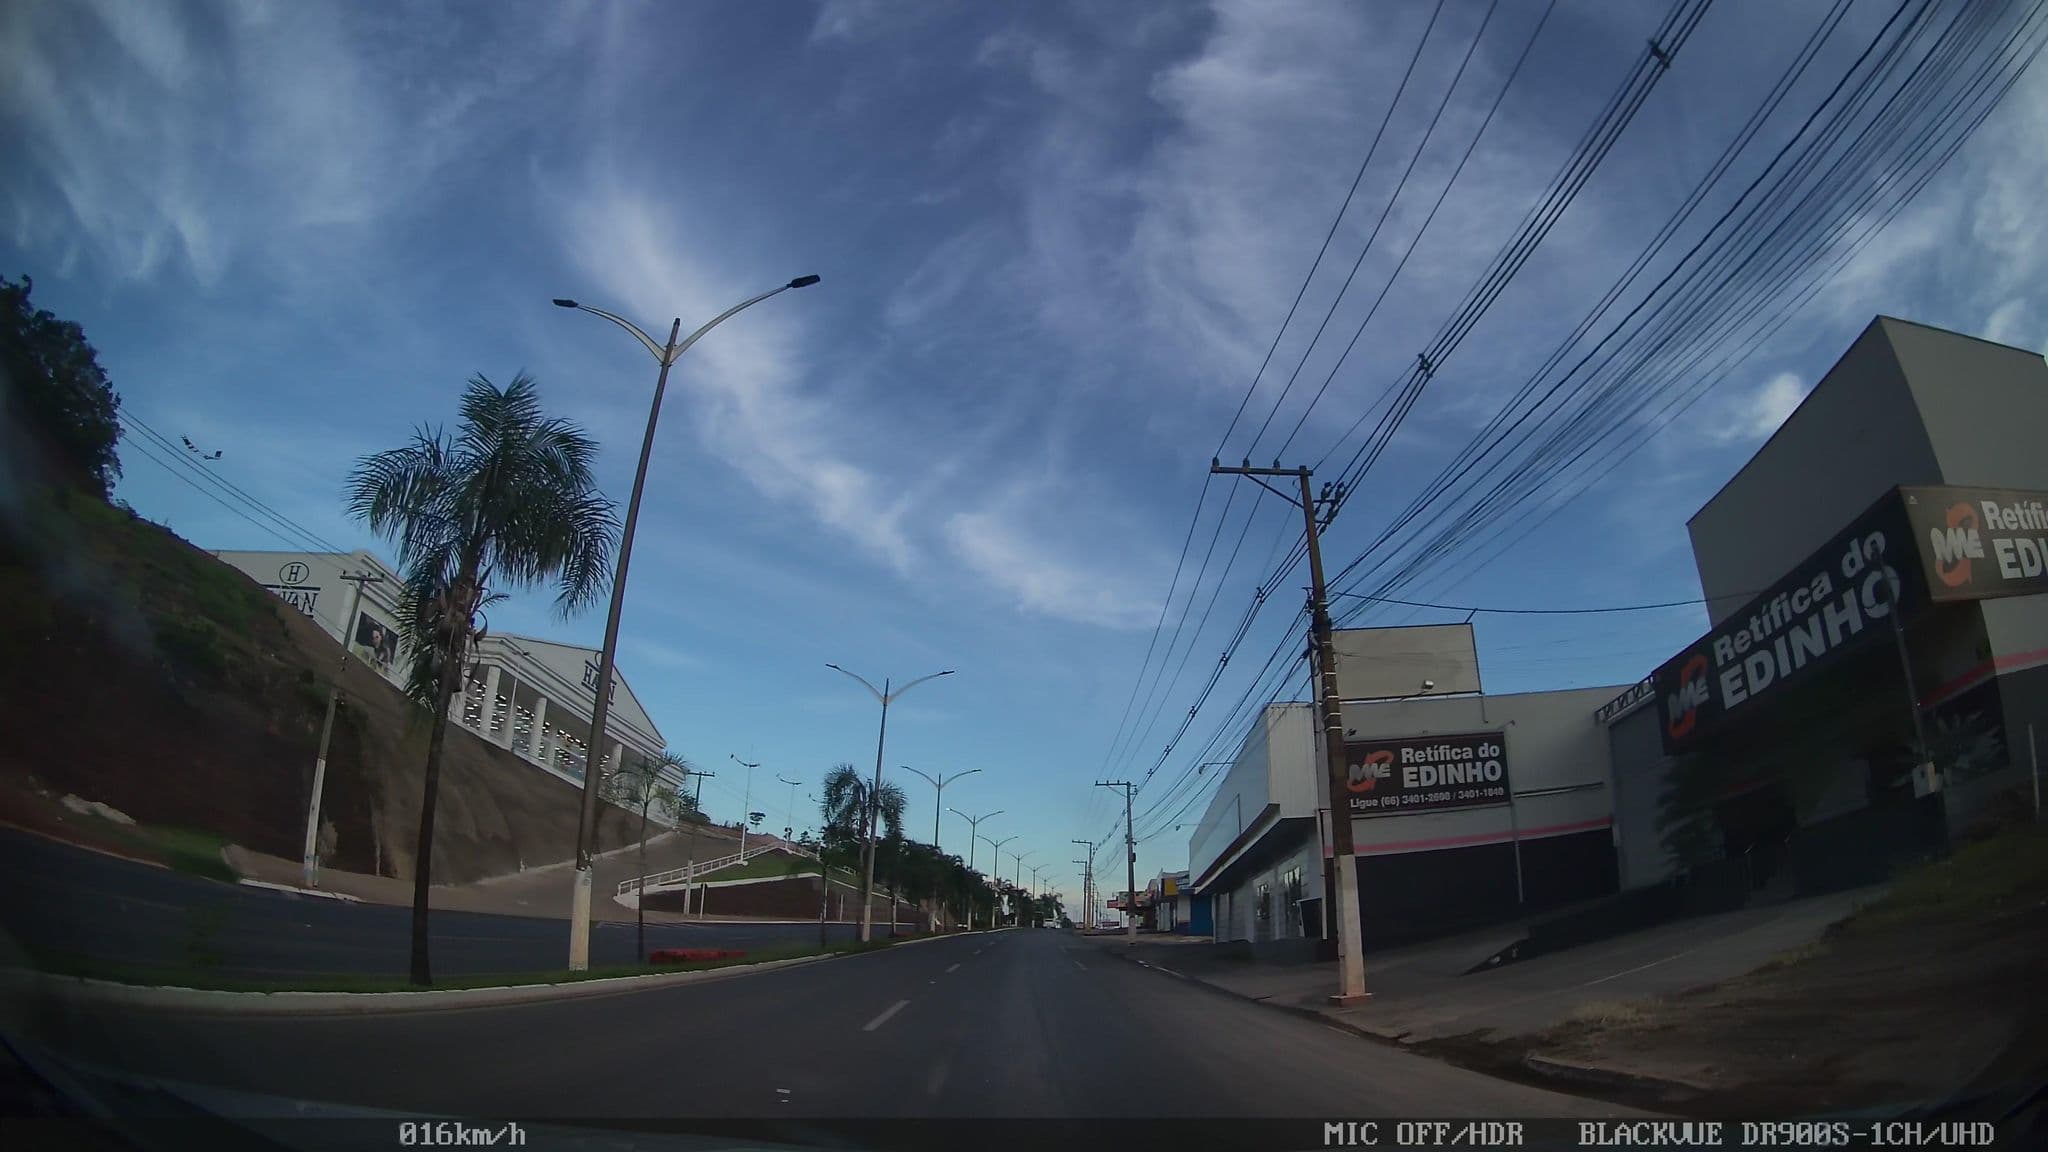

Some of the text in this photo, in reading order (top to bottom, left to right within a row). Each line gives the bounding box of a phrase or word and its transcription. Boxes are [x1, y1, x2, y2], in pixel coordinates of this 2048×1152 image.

[1981, 500, 2048, 530] Retífi
[1713, 531, 1886, 666] Retífica do
[1720, 565, 1900, 710] EDINHO
[1401, 742, 1500, 764] Retífica do
[1402, 760, 1502, 788] EDINHO
[1350, 798, 1379, 809] Ligue
